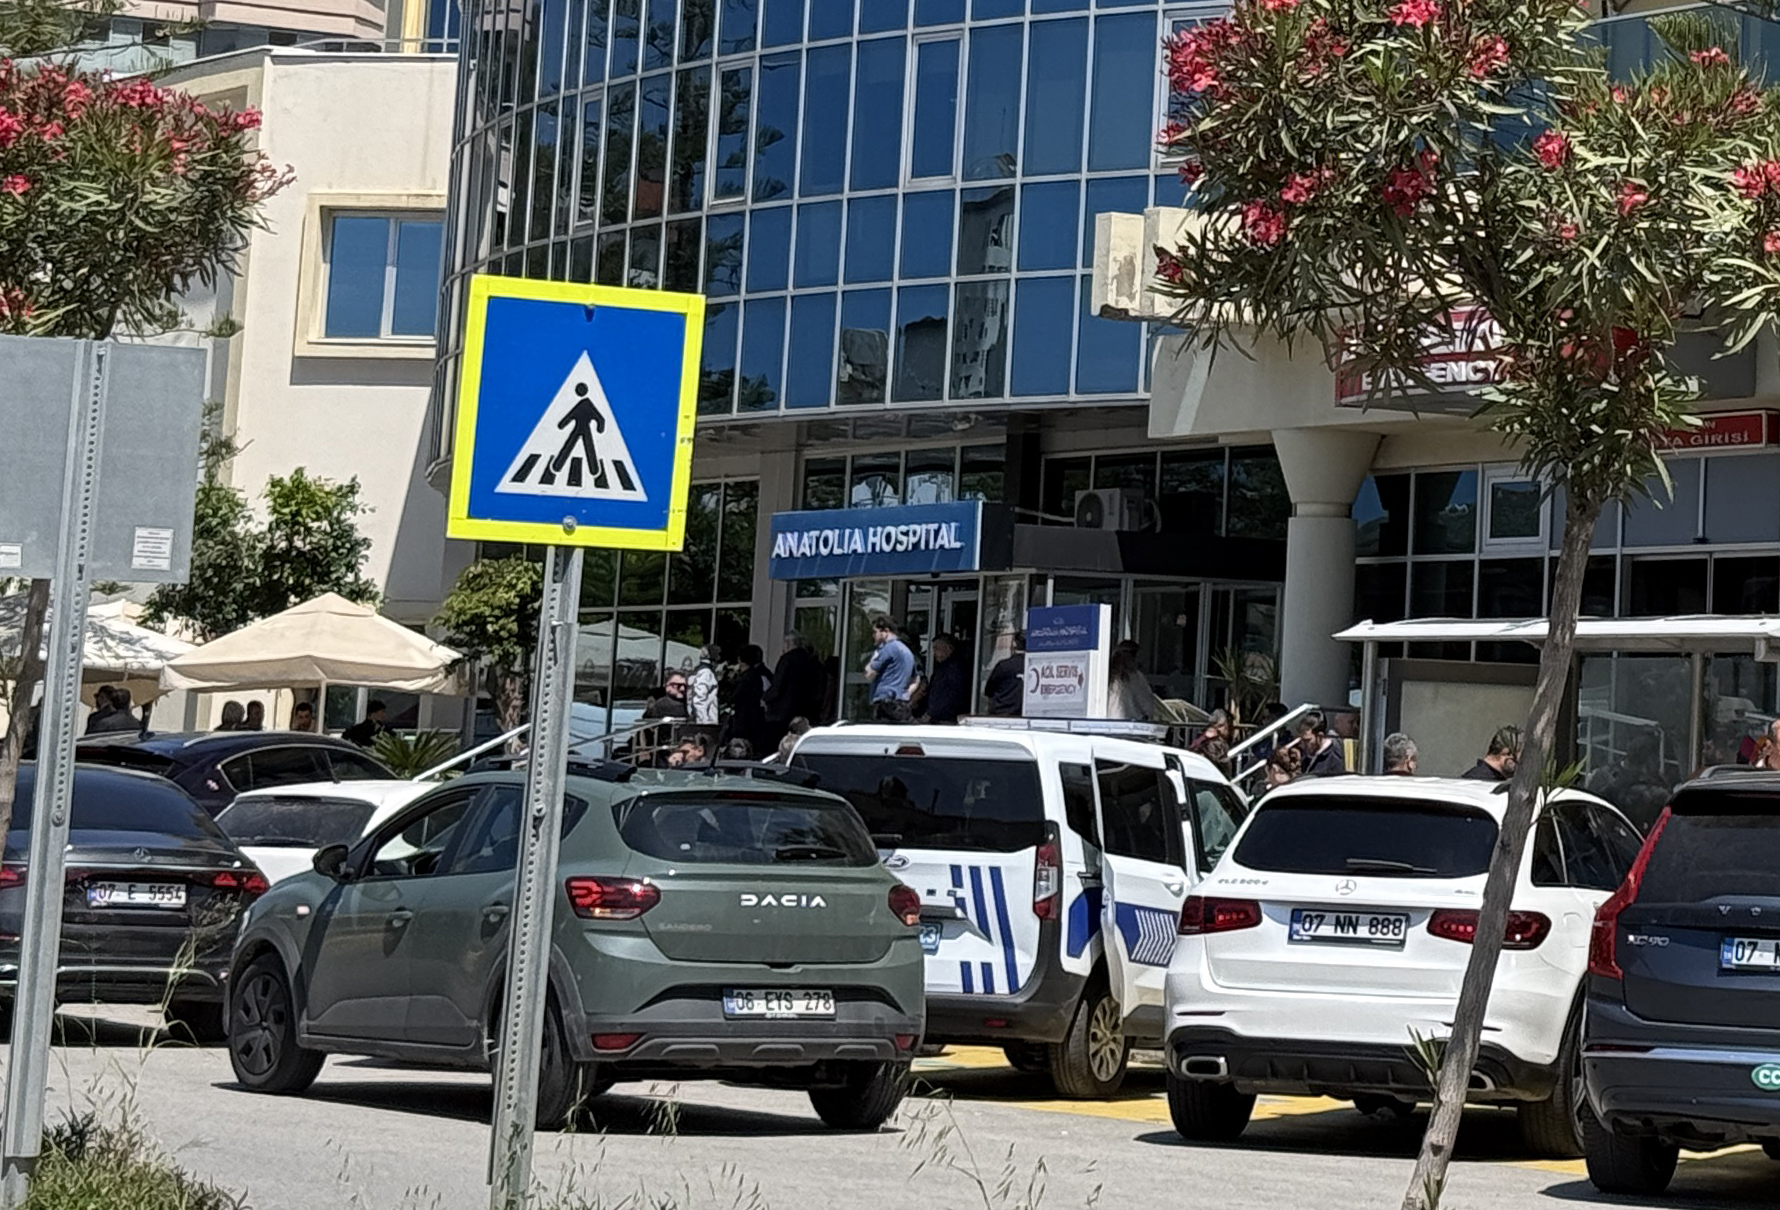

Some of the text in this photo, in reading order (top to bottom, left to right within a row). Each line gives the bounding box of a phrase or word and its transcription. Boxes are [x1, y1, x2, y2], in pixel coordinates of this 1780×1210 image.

[771, 522, 963, 558] ANATOLIA HOSPITAL
[98, 883, 116, 901] 07
[127, 883, 137, 900] E
[740, 894, 827, 908] DACIA
[1301, 914, 1402, 937] 07 NN 888
[1734, 941, 1758, 962] 07
[736, 991, 832, 1011] 06 EYS 278
